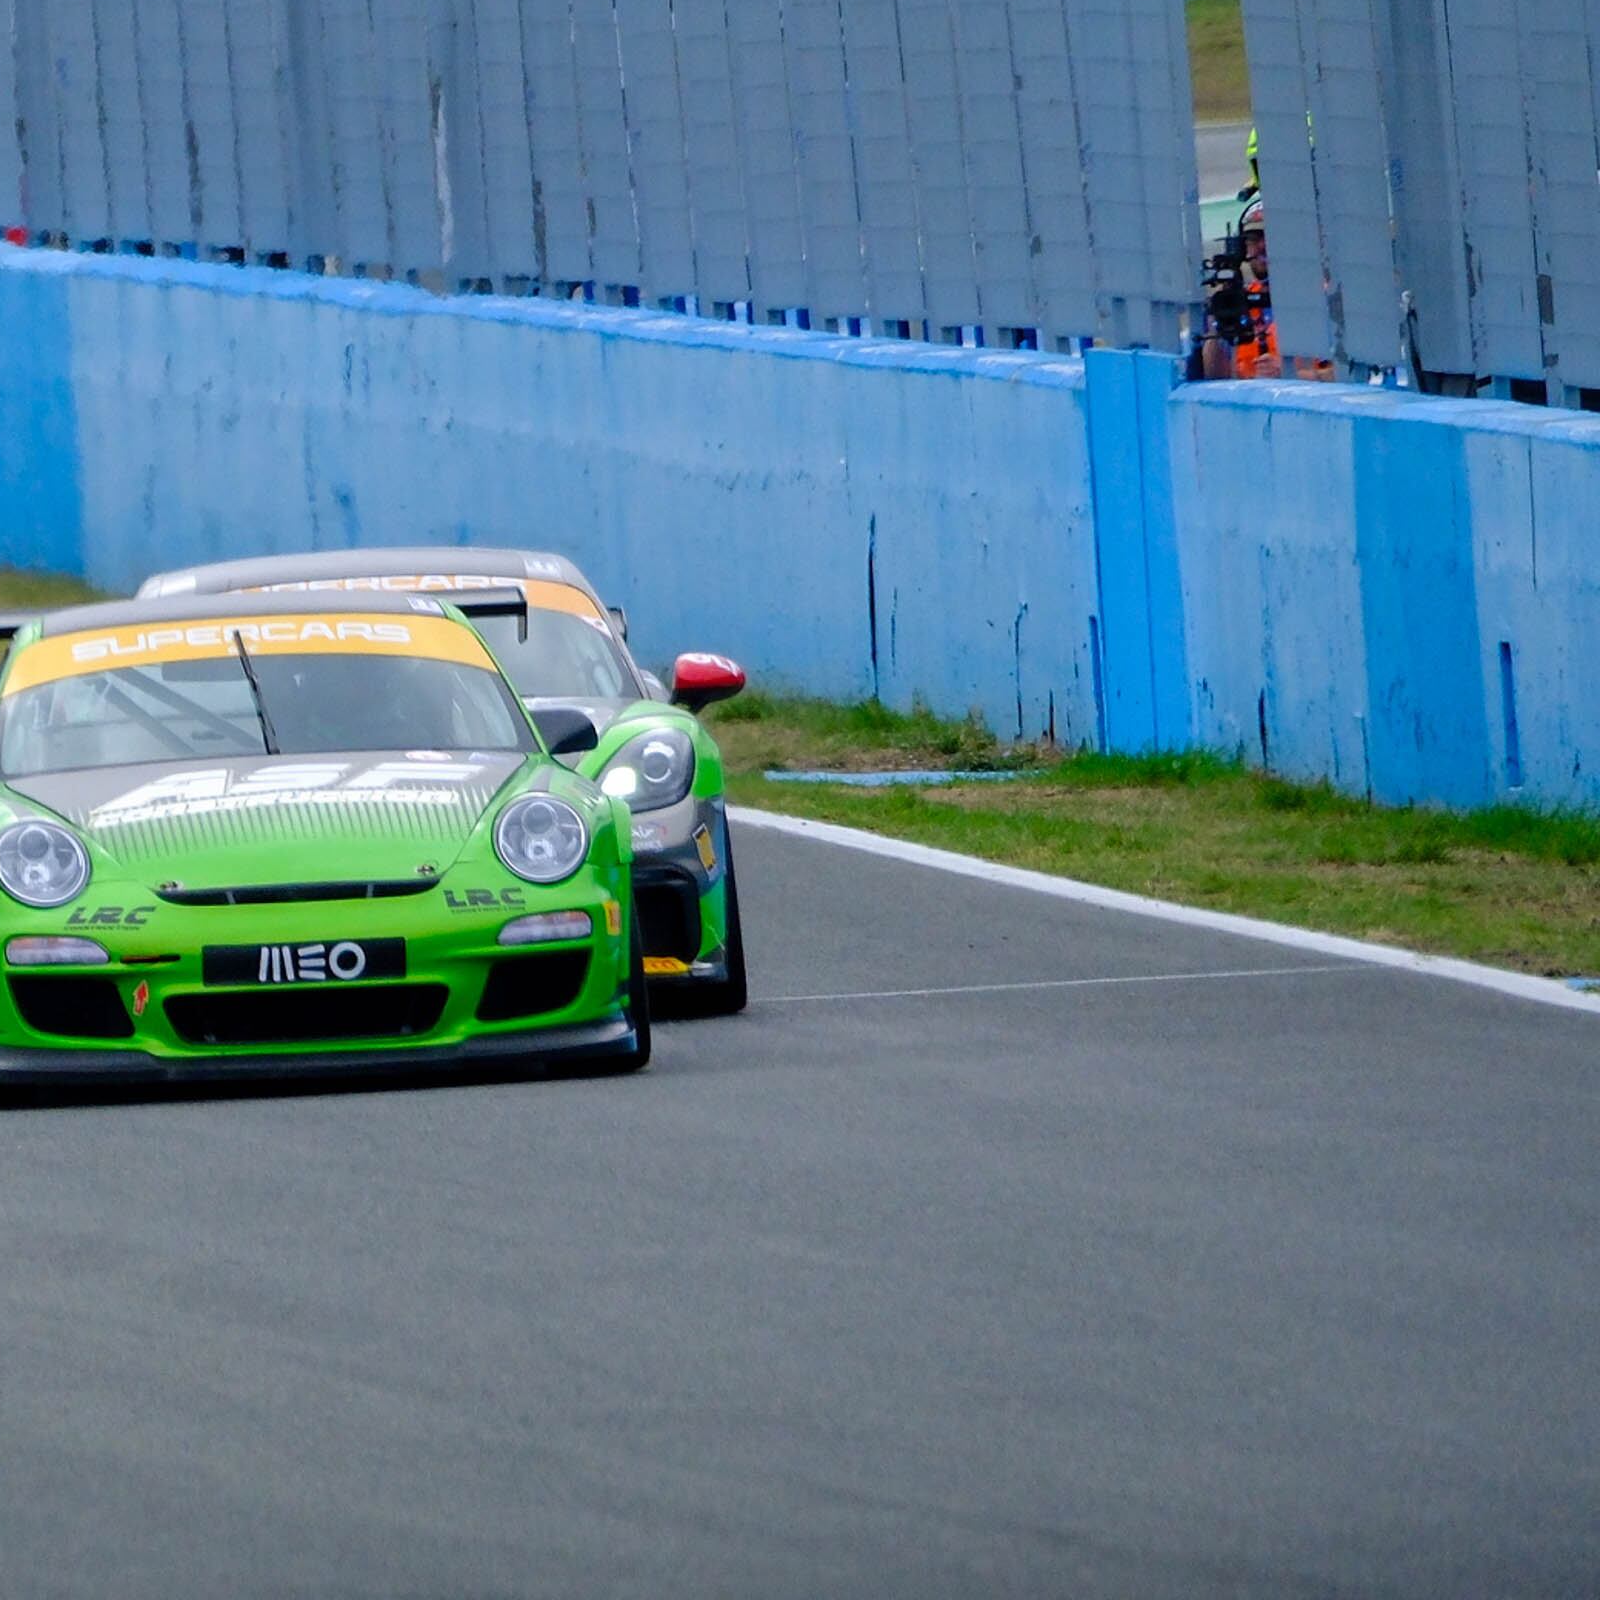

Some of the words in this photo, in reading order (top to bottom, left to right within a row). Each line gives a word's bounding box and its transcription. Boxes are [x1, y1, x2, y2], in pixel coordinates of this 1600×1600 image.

[71, 621, 413, 662] SUPERCARS
[442, 888, 527, 907] LRC
[66, 906, 157, 925] LRC
[259, 941, 367, 983] MEO
